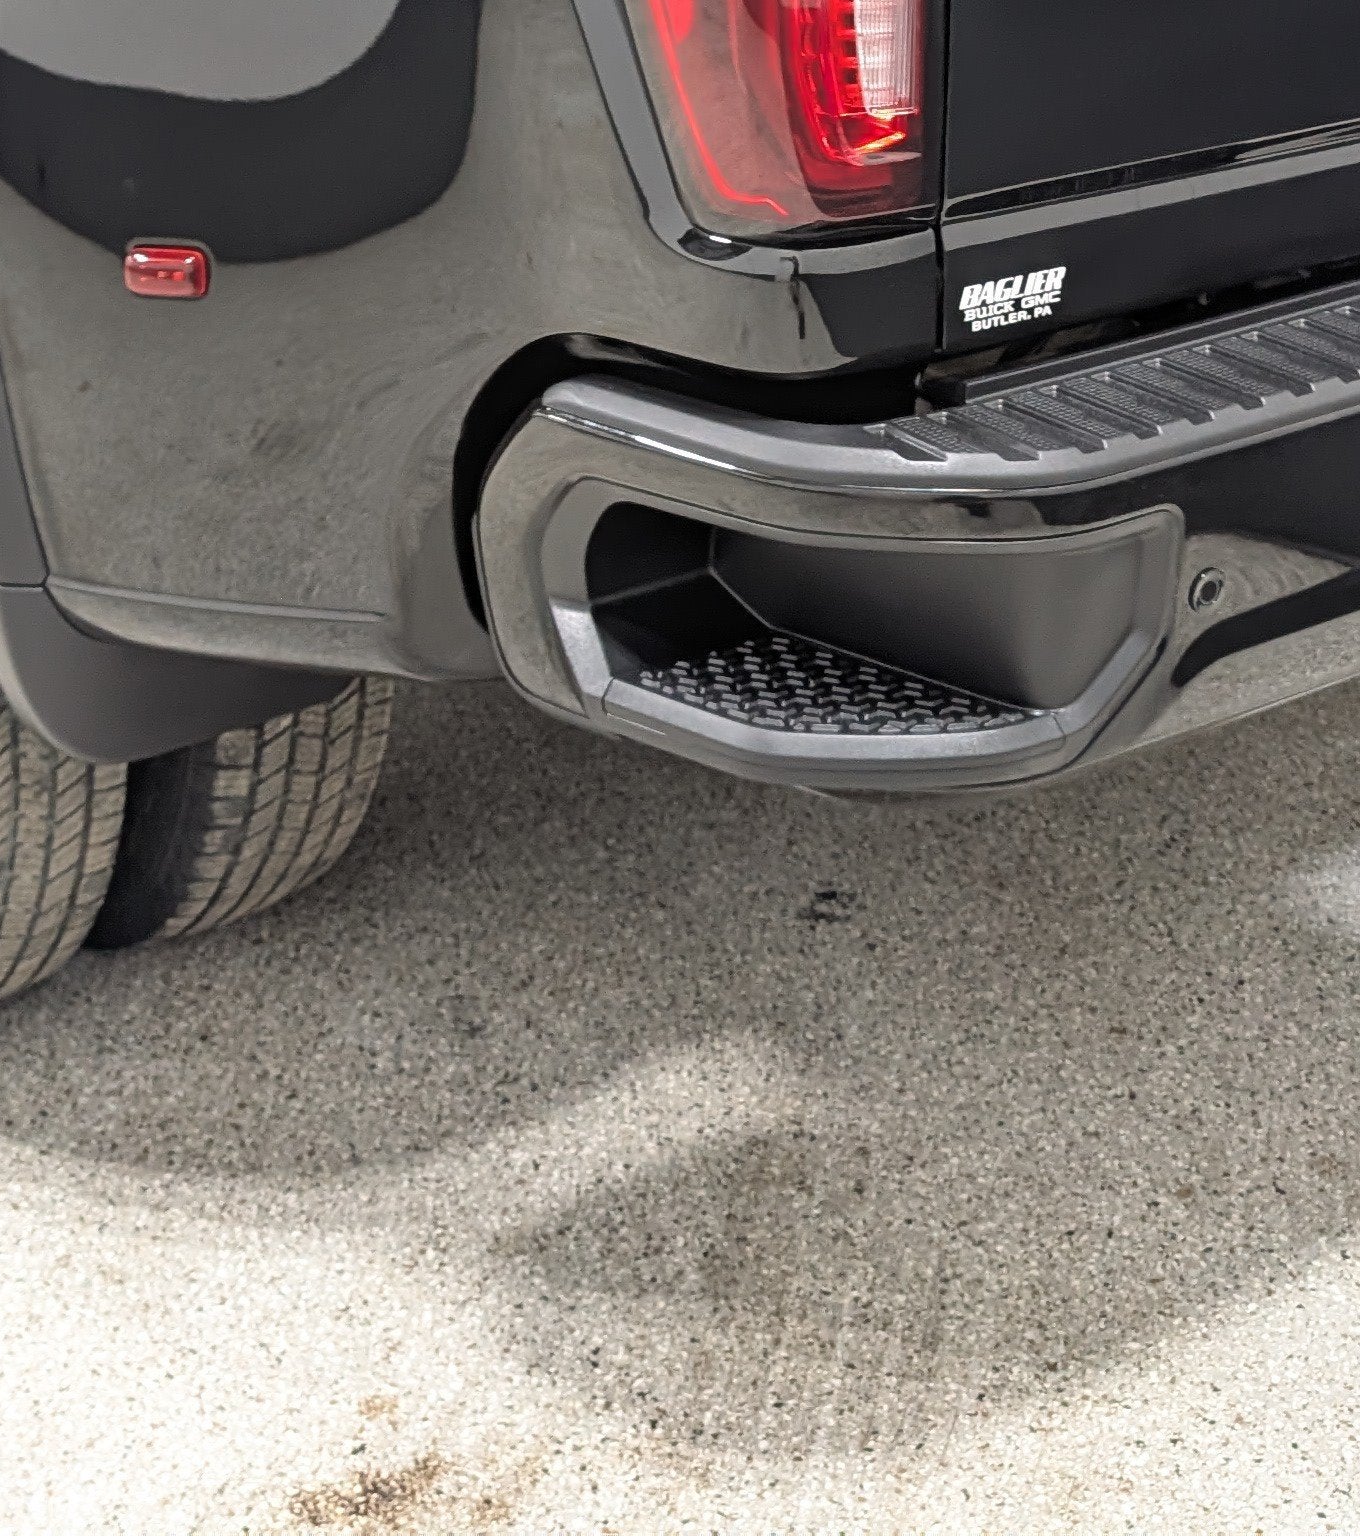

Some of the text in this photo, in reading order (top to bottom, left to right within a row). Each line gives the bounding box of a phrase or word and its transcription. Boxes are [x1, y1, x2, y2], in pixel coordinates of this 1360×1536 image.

[958, 265, 1067, 310] BAGLIER
[963, 290, 1061, 322] BUICK GMC
[1033, 305, 1052, 318] PA
